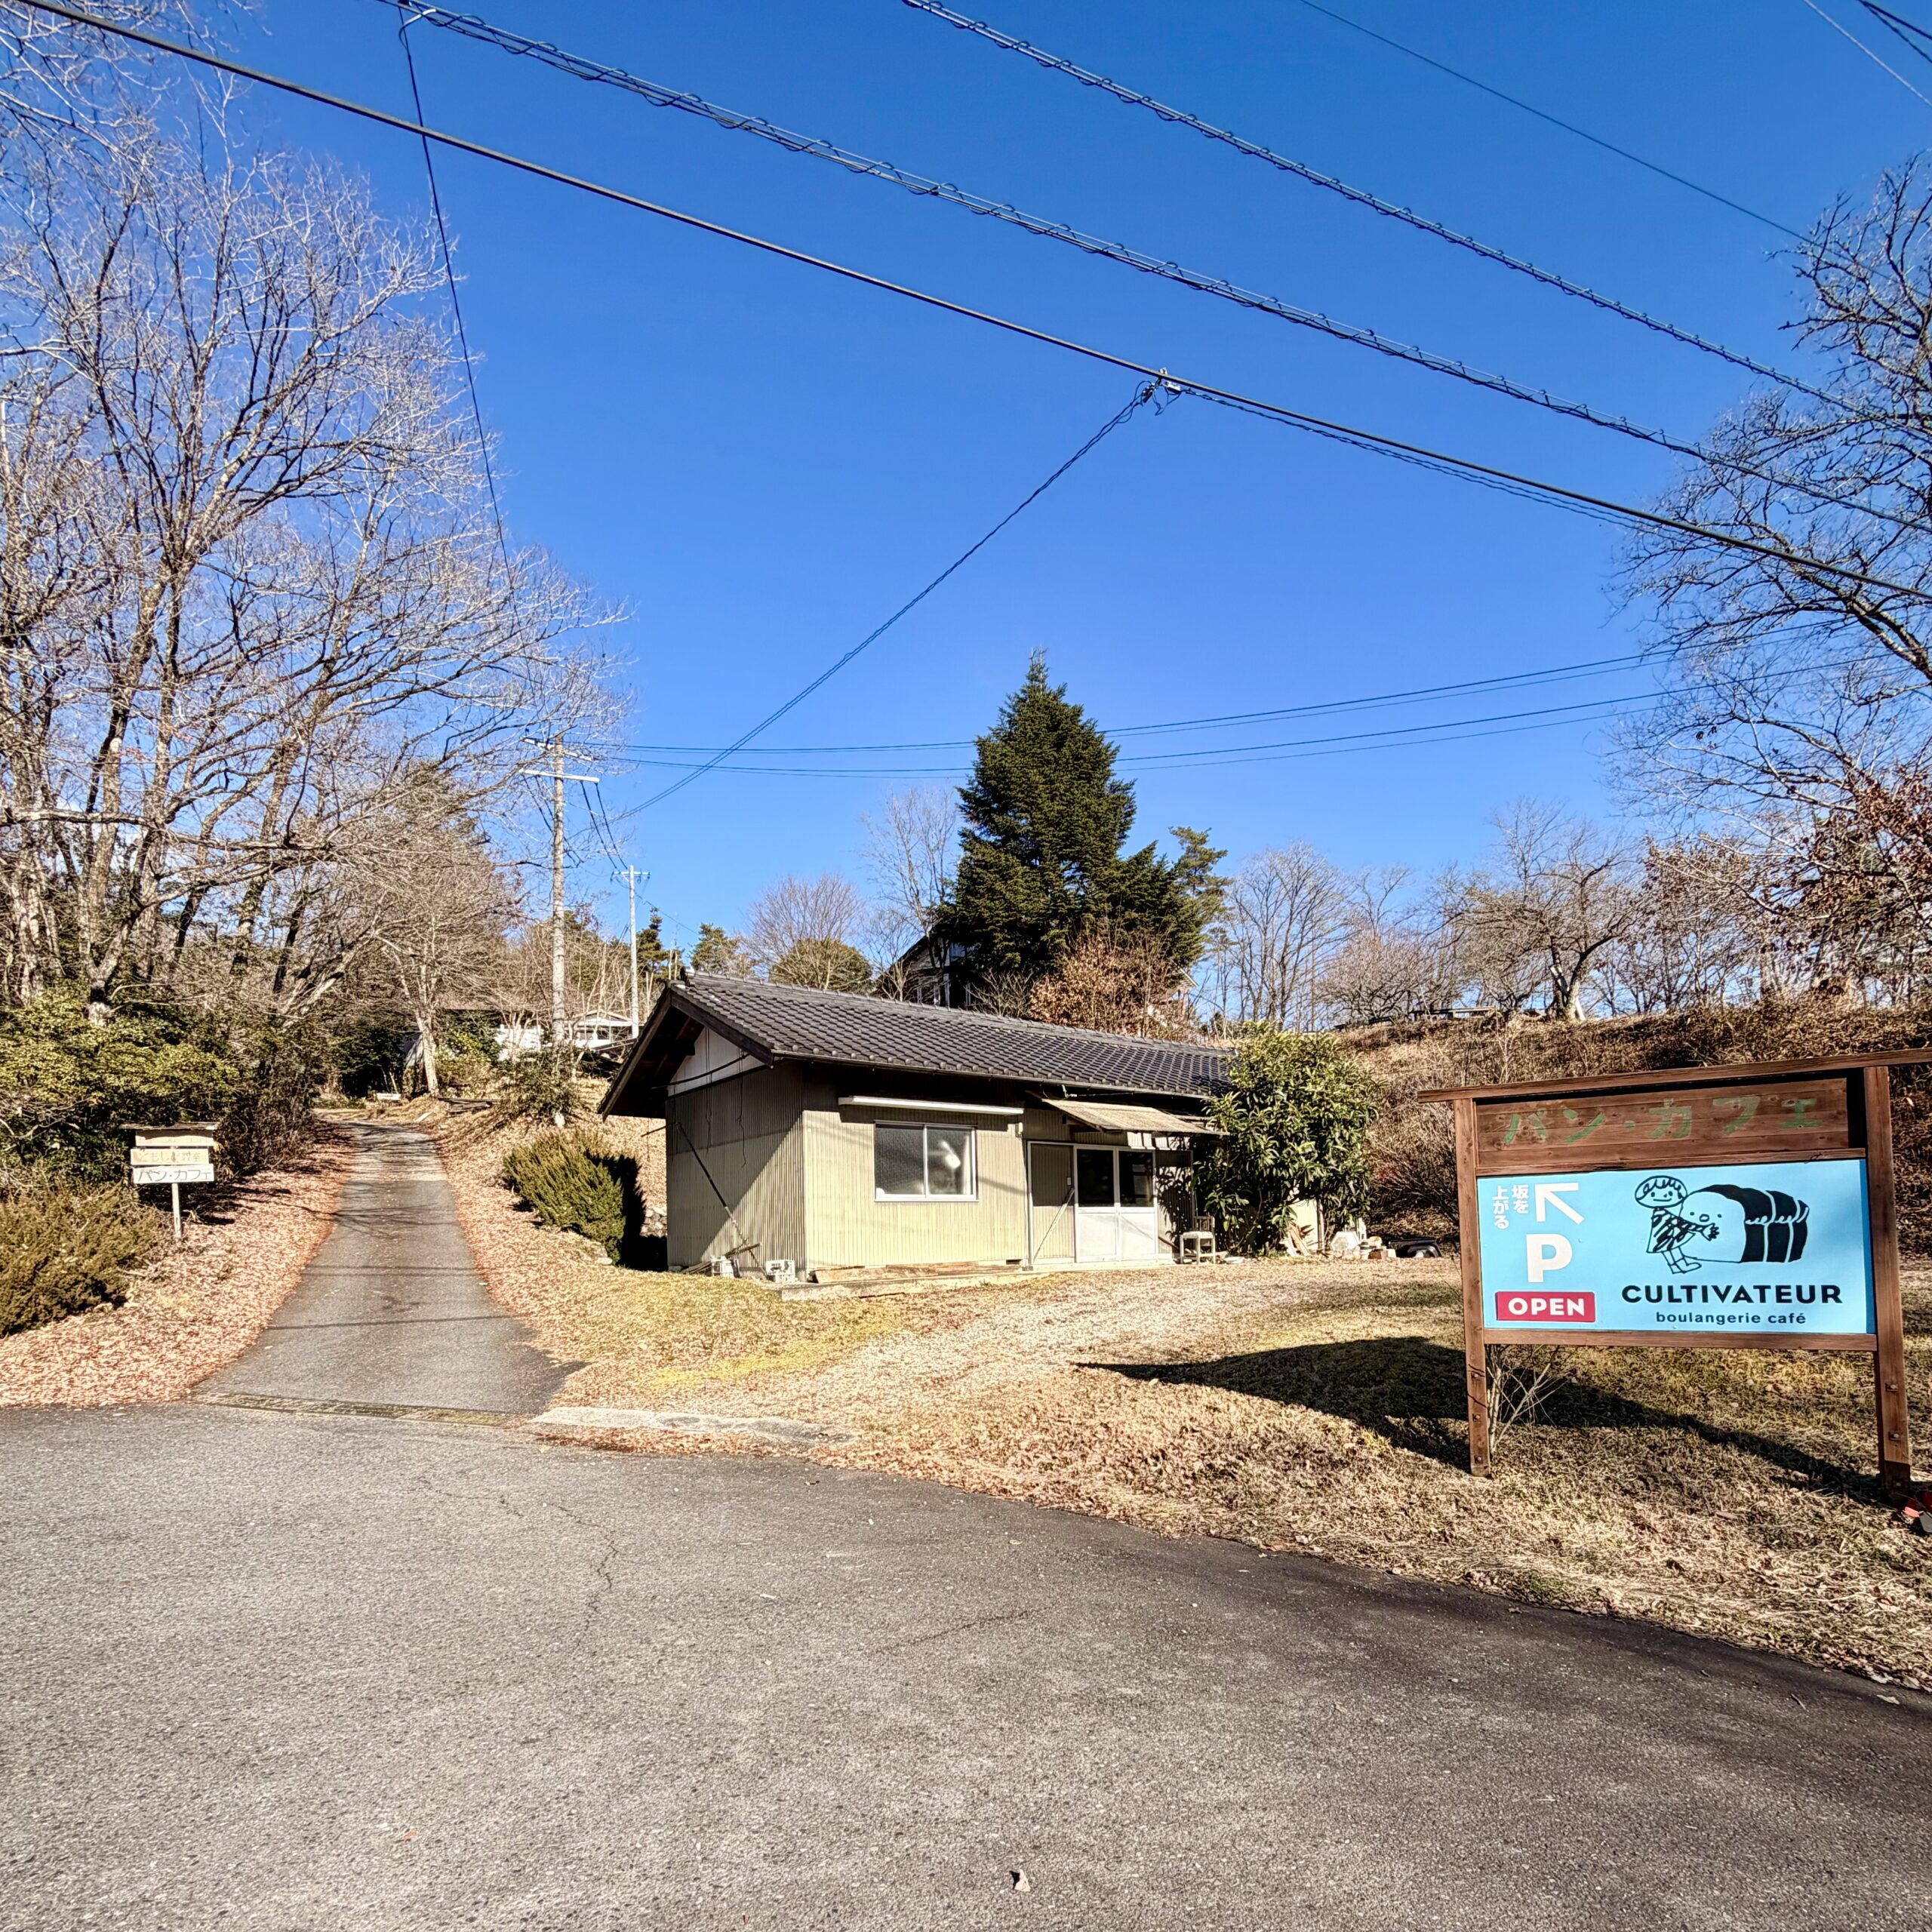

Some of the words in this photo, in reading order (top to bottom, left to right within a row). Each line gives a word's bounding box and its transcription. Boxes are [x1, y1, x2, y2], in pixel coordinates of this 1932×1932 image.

[1493, 1186, 1509, 1229] 上がる
[1512, 1184, 1529, 1214] 坂を
[1526, 1233, 1573, 1283] P
[1508, 1297, 1585, 1316] OPEN
[1621, 1284, 1842, 1304] CULTIVATEUR
[1656, 1312, 1761, 1325] boulangerie
[1767, 1312, 1807, 1324] café
